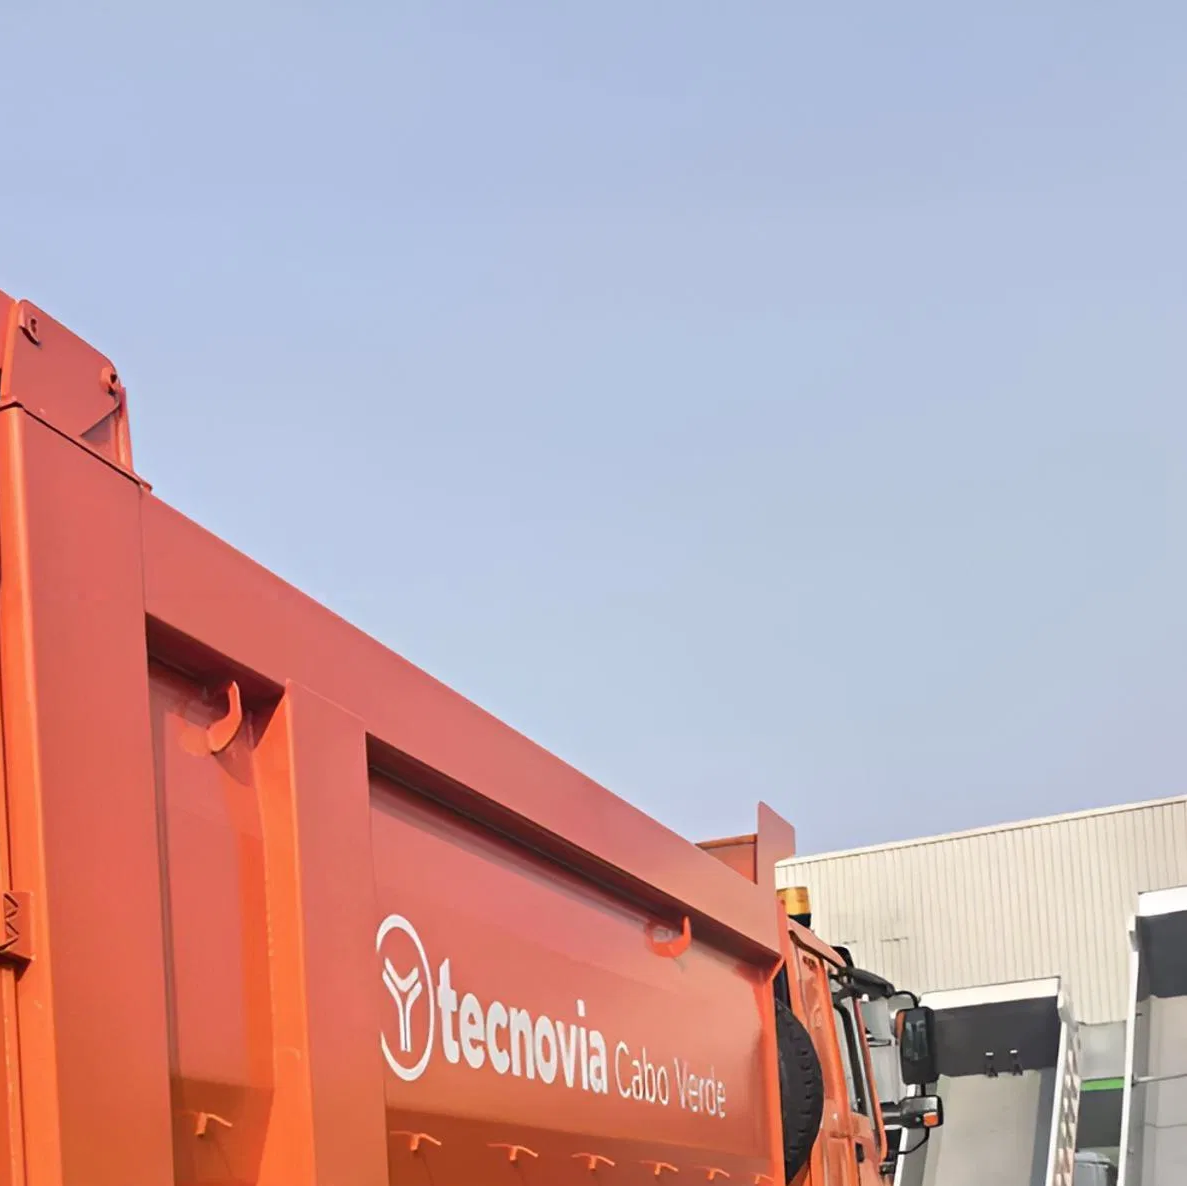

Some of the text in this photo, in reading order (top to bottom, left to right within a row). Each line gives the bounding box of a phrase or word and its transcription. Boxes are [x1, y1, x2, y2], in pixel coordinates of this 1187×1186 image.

[437, 957, 726, 1118] tecnovia Cabo Verde
